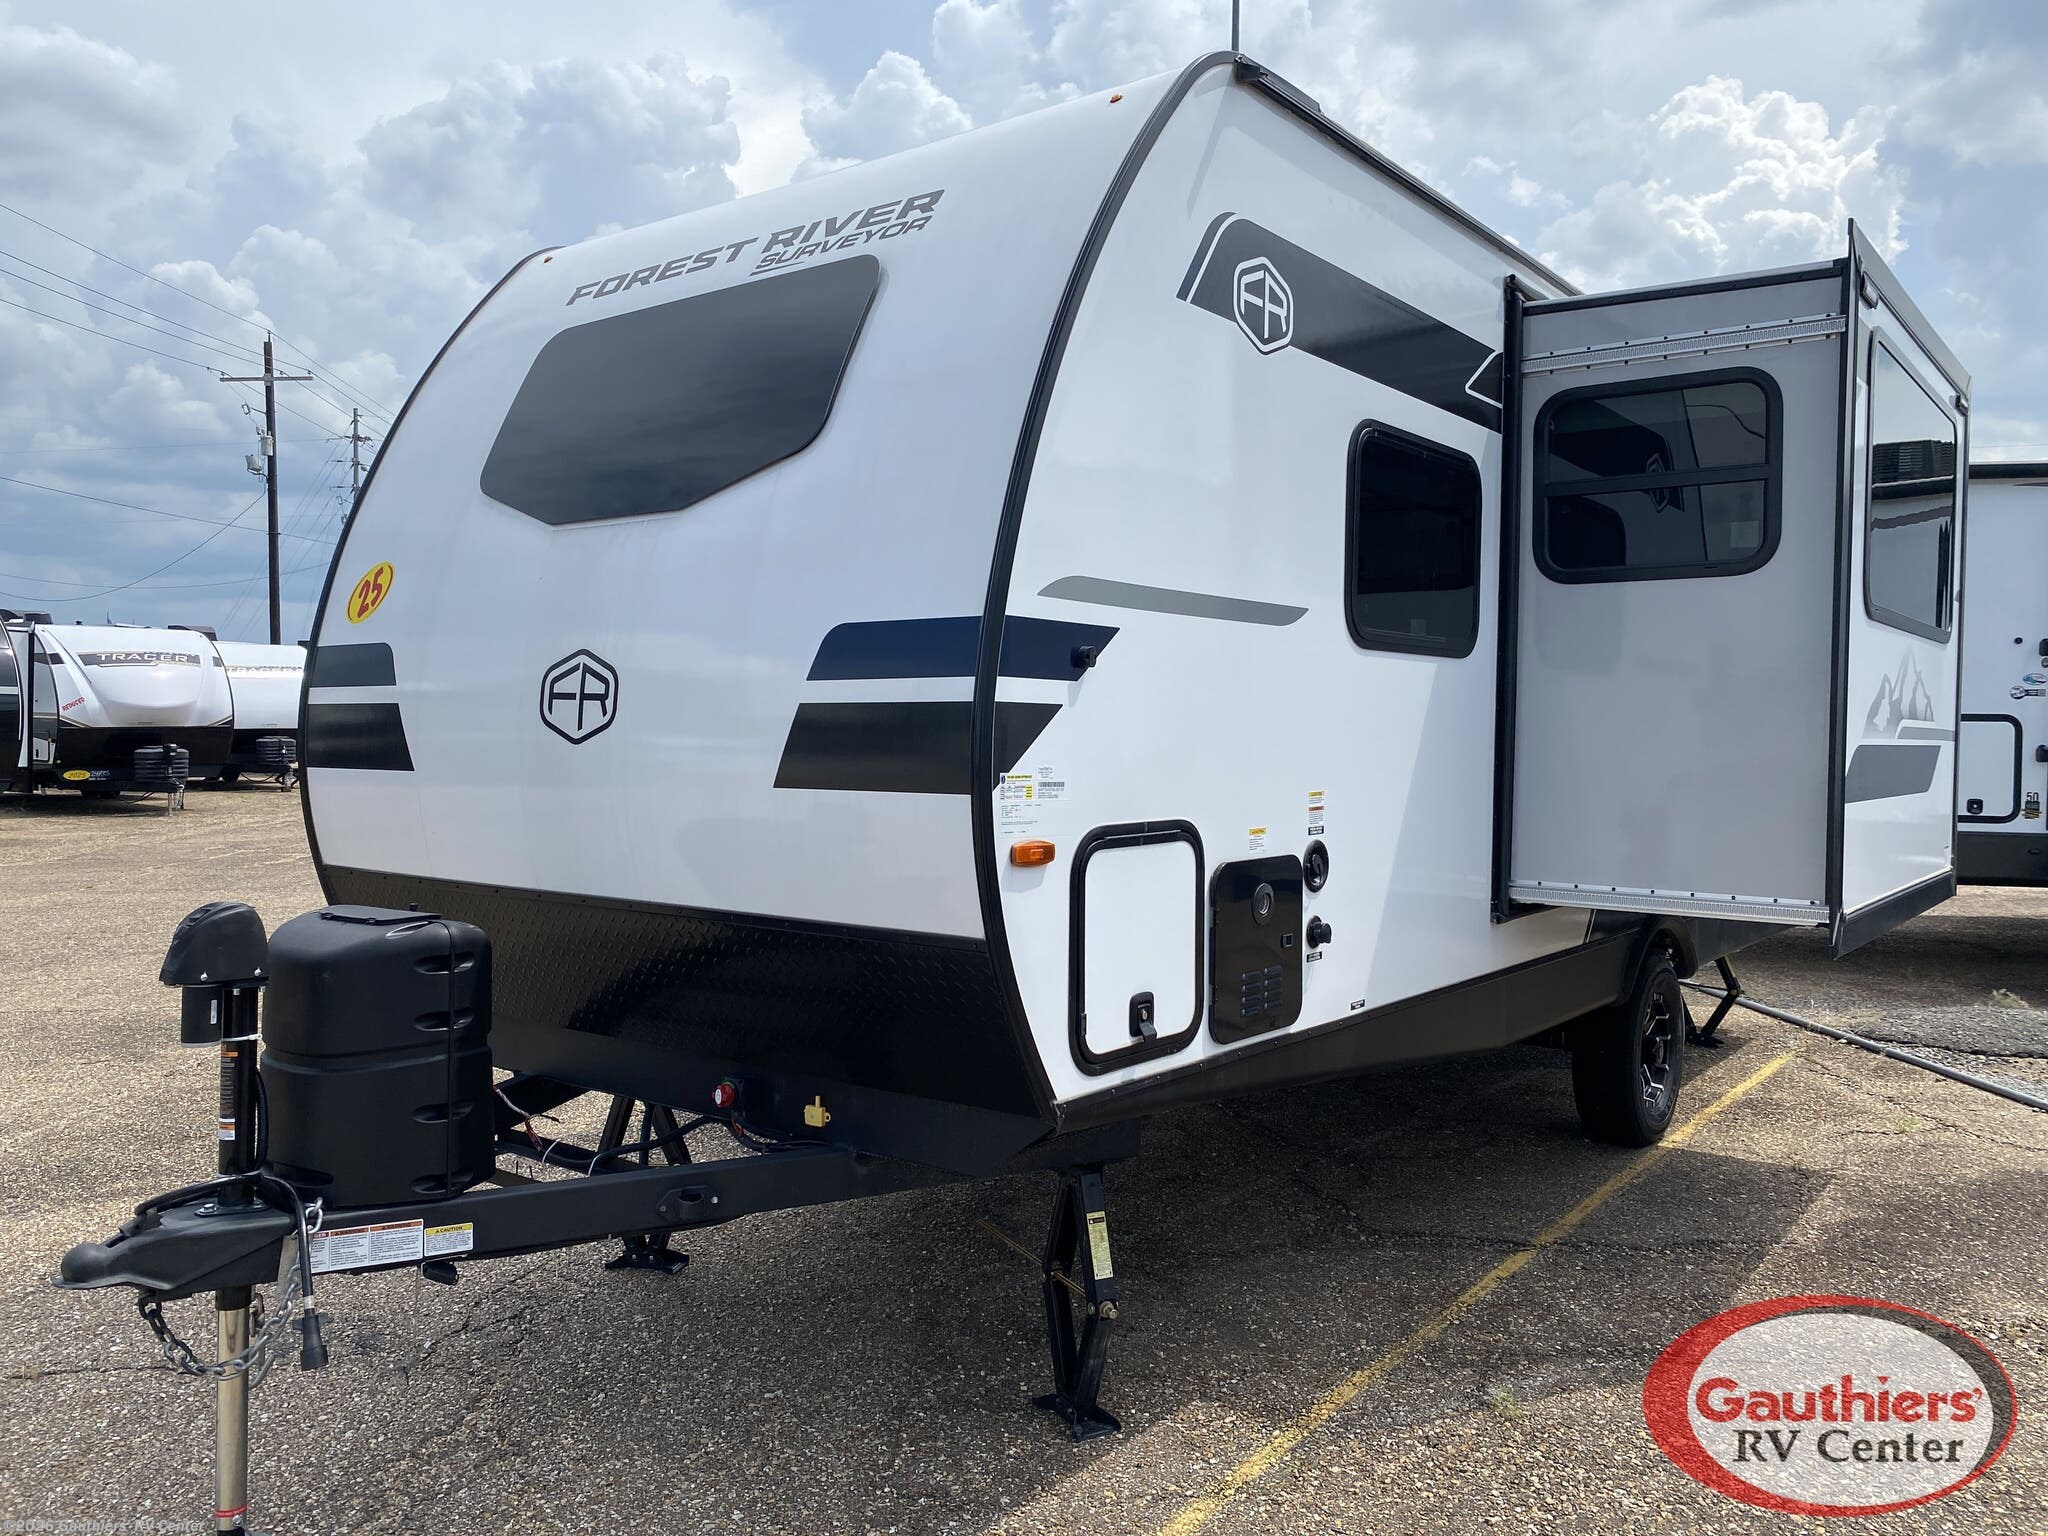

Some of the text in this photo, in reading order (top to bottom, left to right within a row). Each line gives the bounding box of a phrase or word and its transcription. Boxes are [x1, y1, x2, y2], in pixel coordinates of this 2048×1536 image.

[566, 188, 946, 307] FOREST RIVER
[755, 216, 933, 270] SURVEYOR
[357, 566, 384, 619] 25
[97, 652, 188, 663] TRACER
[2026, 791, 2040, 802] 50
[440, 1226, 463, 1234] CAUTION
